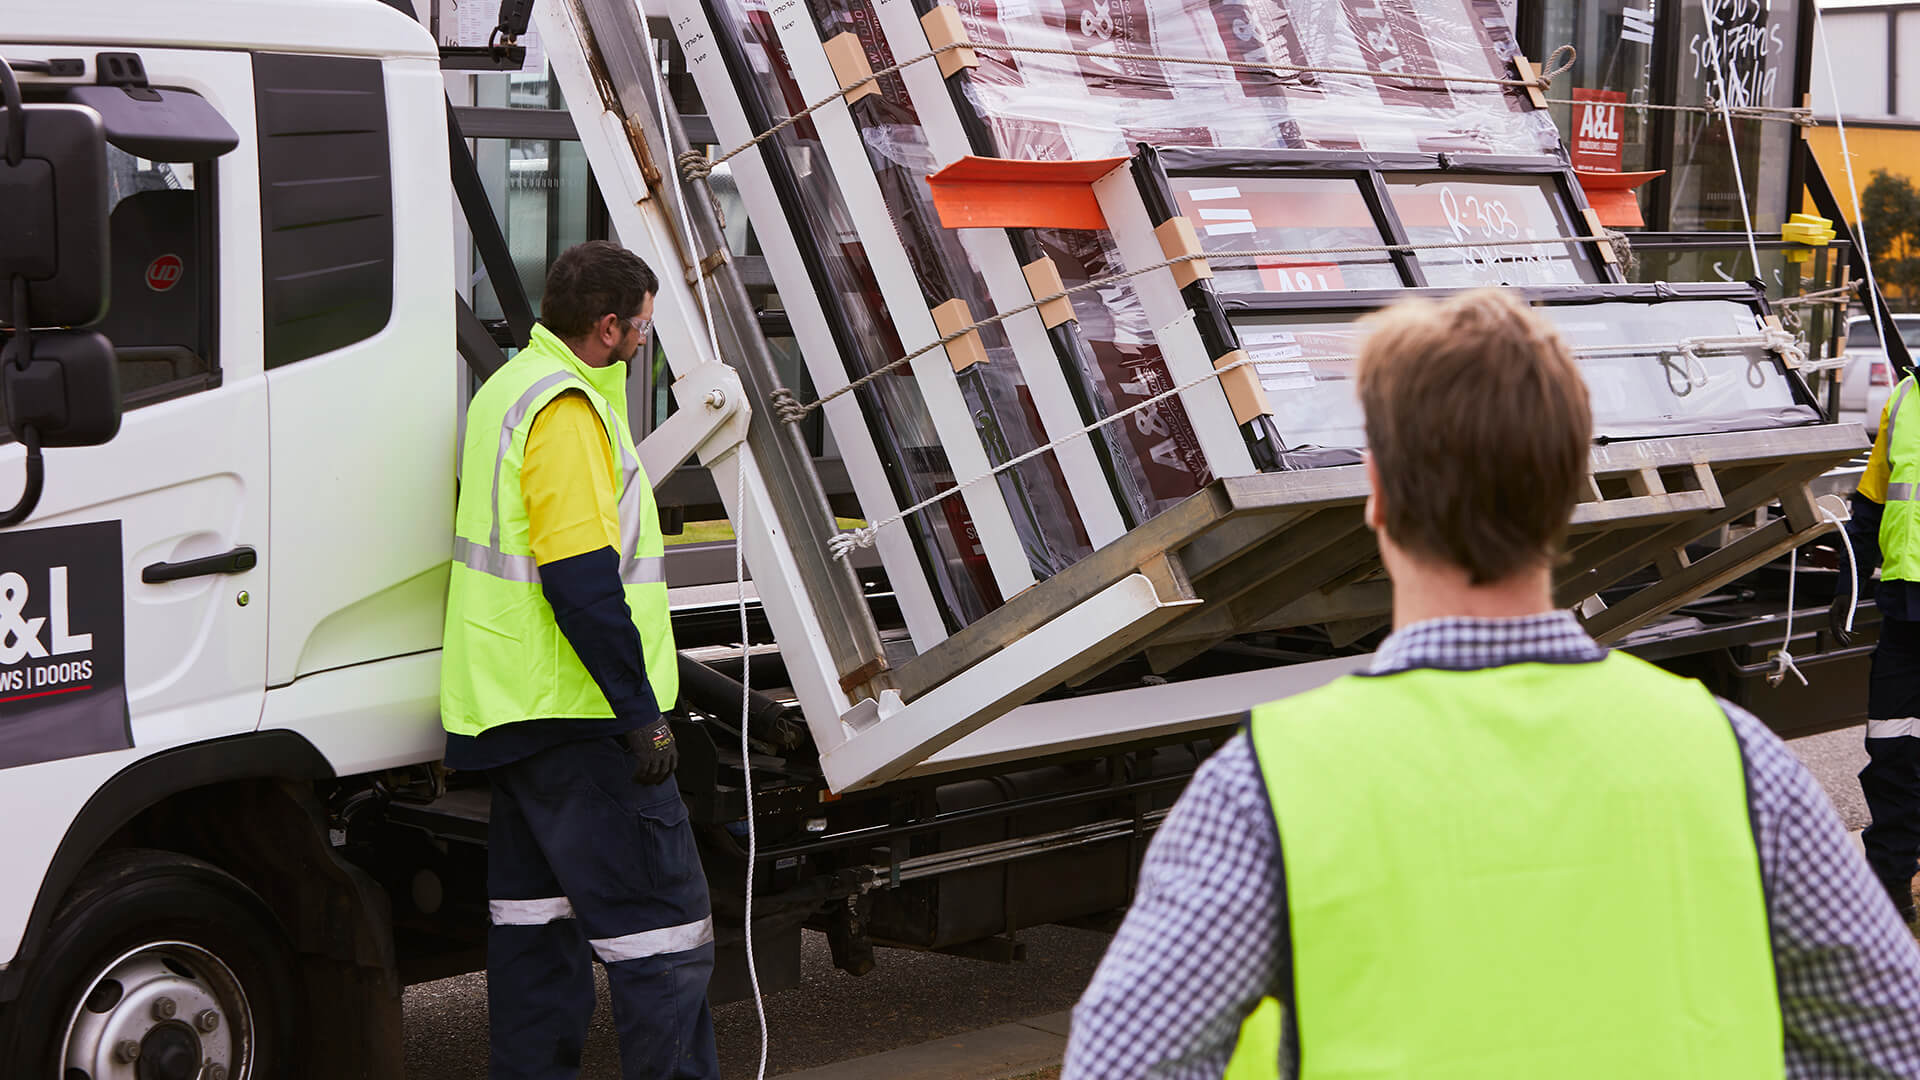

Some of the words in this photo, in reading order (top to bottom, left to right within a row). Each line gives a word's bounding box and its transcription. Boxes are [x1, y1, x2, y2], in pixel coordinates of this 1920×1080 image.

[1580, 101, 1619, 140] A&L
[150, 263, 179, 281] UD
[35, 659, 93, 687] DOORS
